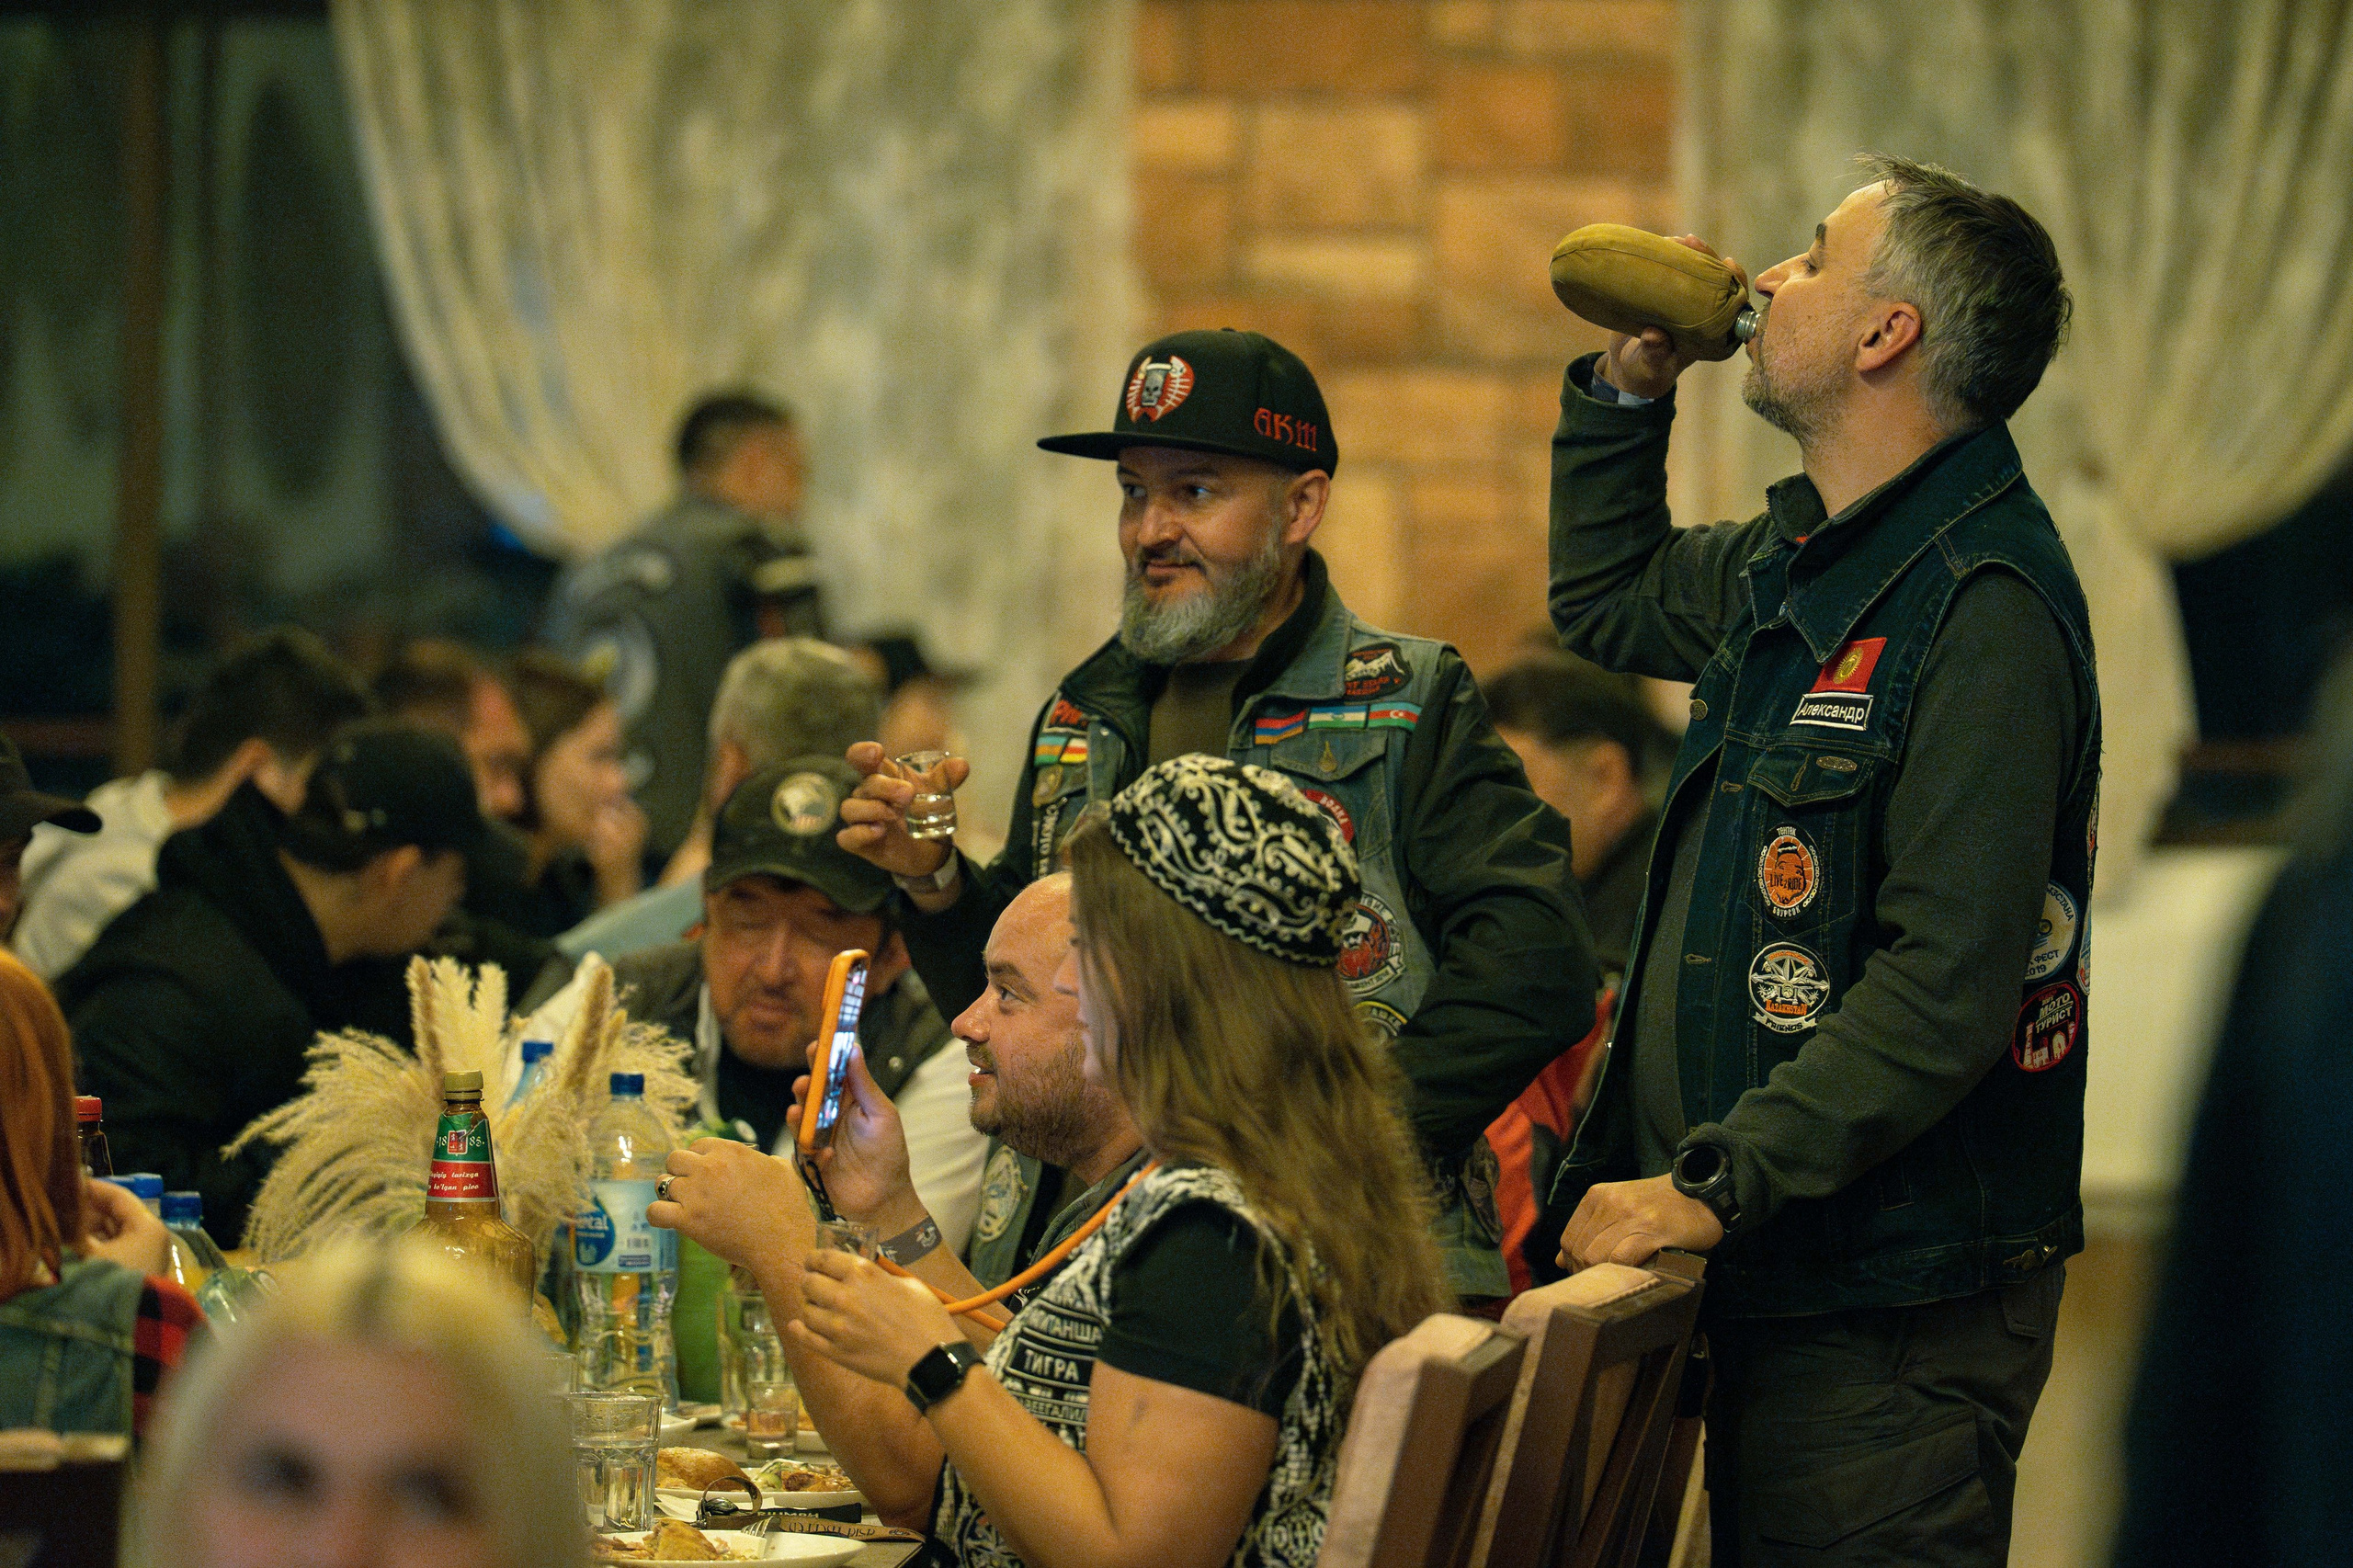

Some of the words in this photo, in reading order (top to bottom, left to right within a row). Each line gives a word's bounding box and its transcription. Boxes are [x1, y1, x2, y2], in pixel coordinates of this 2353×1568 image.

[1797, 702, 1865, 724] Александр
[2034, 949, 2059, 963] ФЕСТ
[2028, 964, 2047, 975] 019
[1765, 998, 1808, 1016] KAZAKHSTAN
[2040, 993, 2071, 1018] МОТО
[1766, 1017, 1803, 1031] FRIENDS
[2036, 1006, 2073, 1033] ТУРИСТ
[1023, 1349, 1080, 1382] ТИГРА
